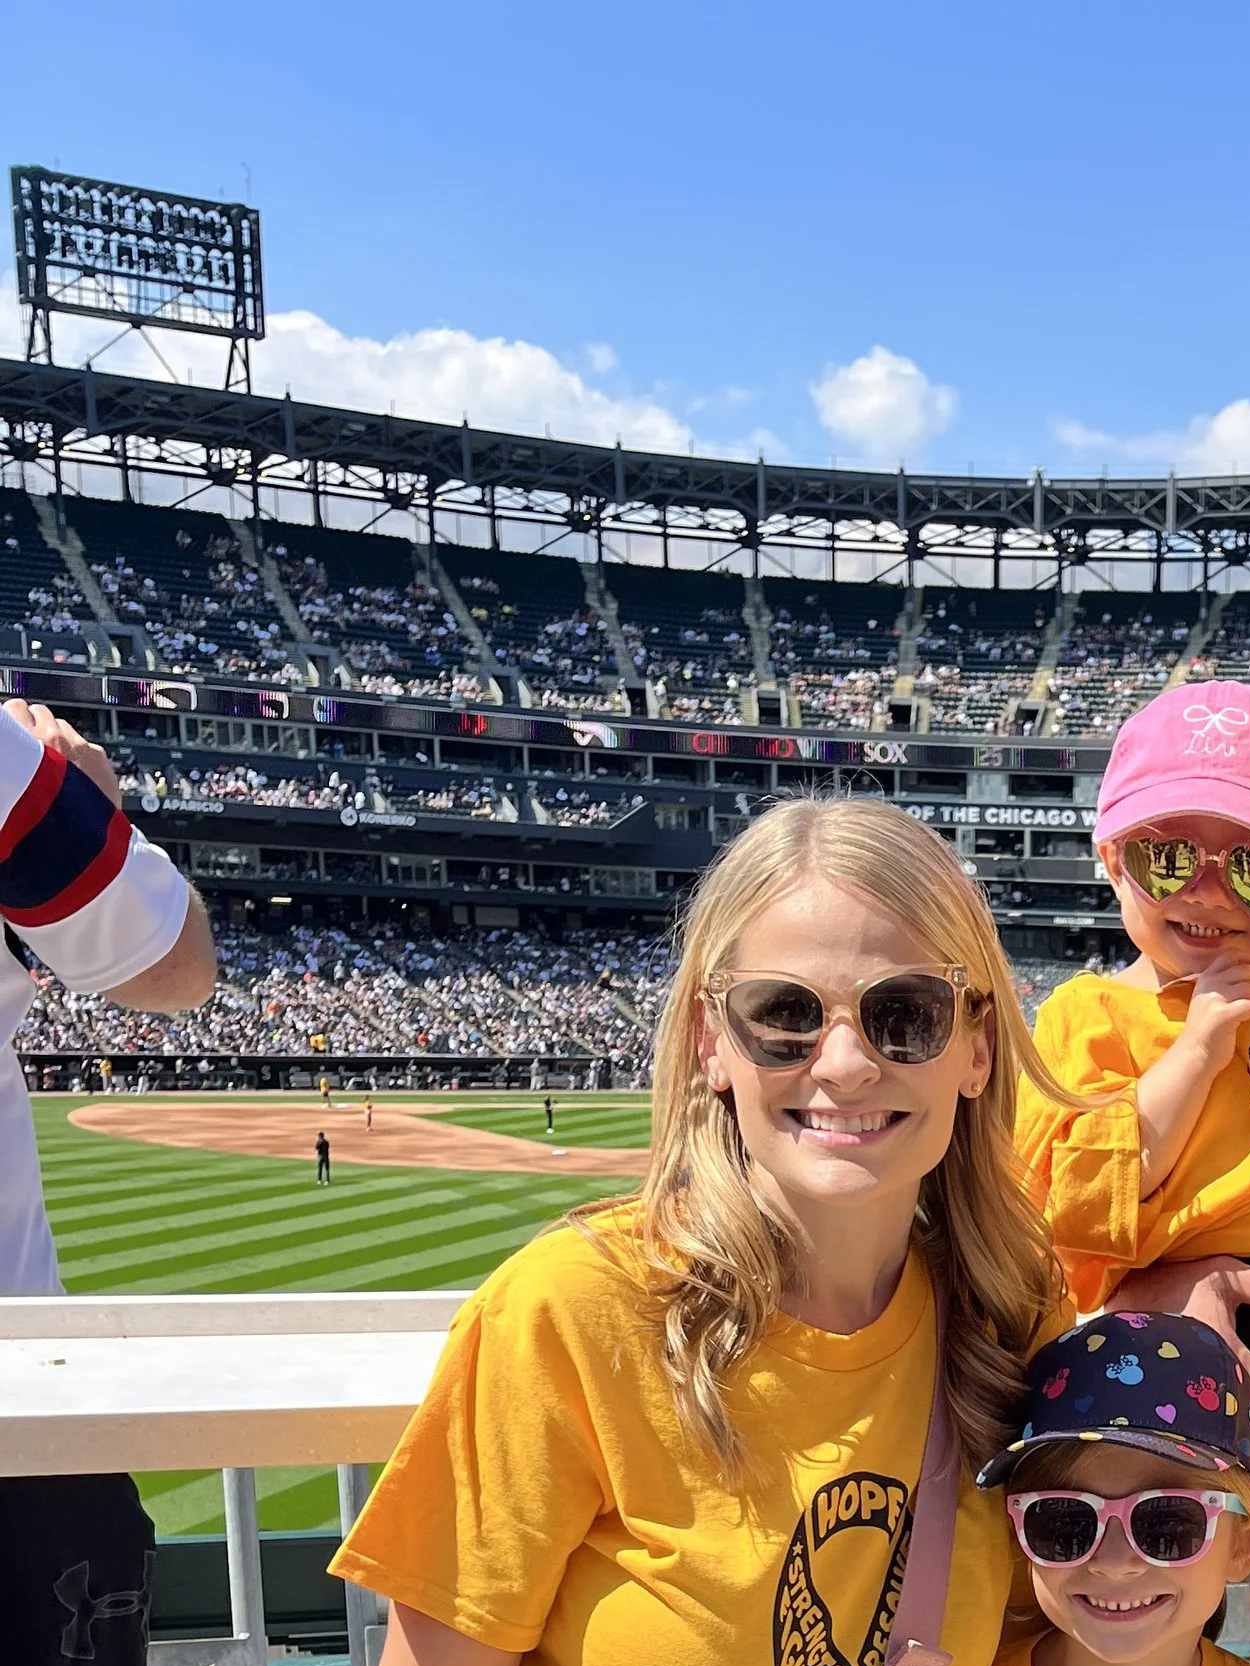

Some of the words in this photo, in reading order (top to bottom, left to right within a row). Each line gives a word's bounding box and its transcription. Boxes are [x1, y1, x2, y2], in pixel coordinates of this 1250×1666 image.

[863, 740, 909, 764] SOX
[162, 798, 224, 813] APARICIO
[940, 806, 980, 823] THE
[984, 807, 1077, 827] CHICAGO
[817, 1479, 904, 1539] HOPE
